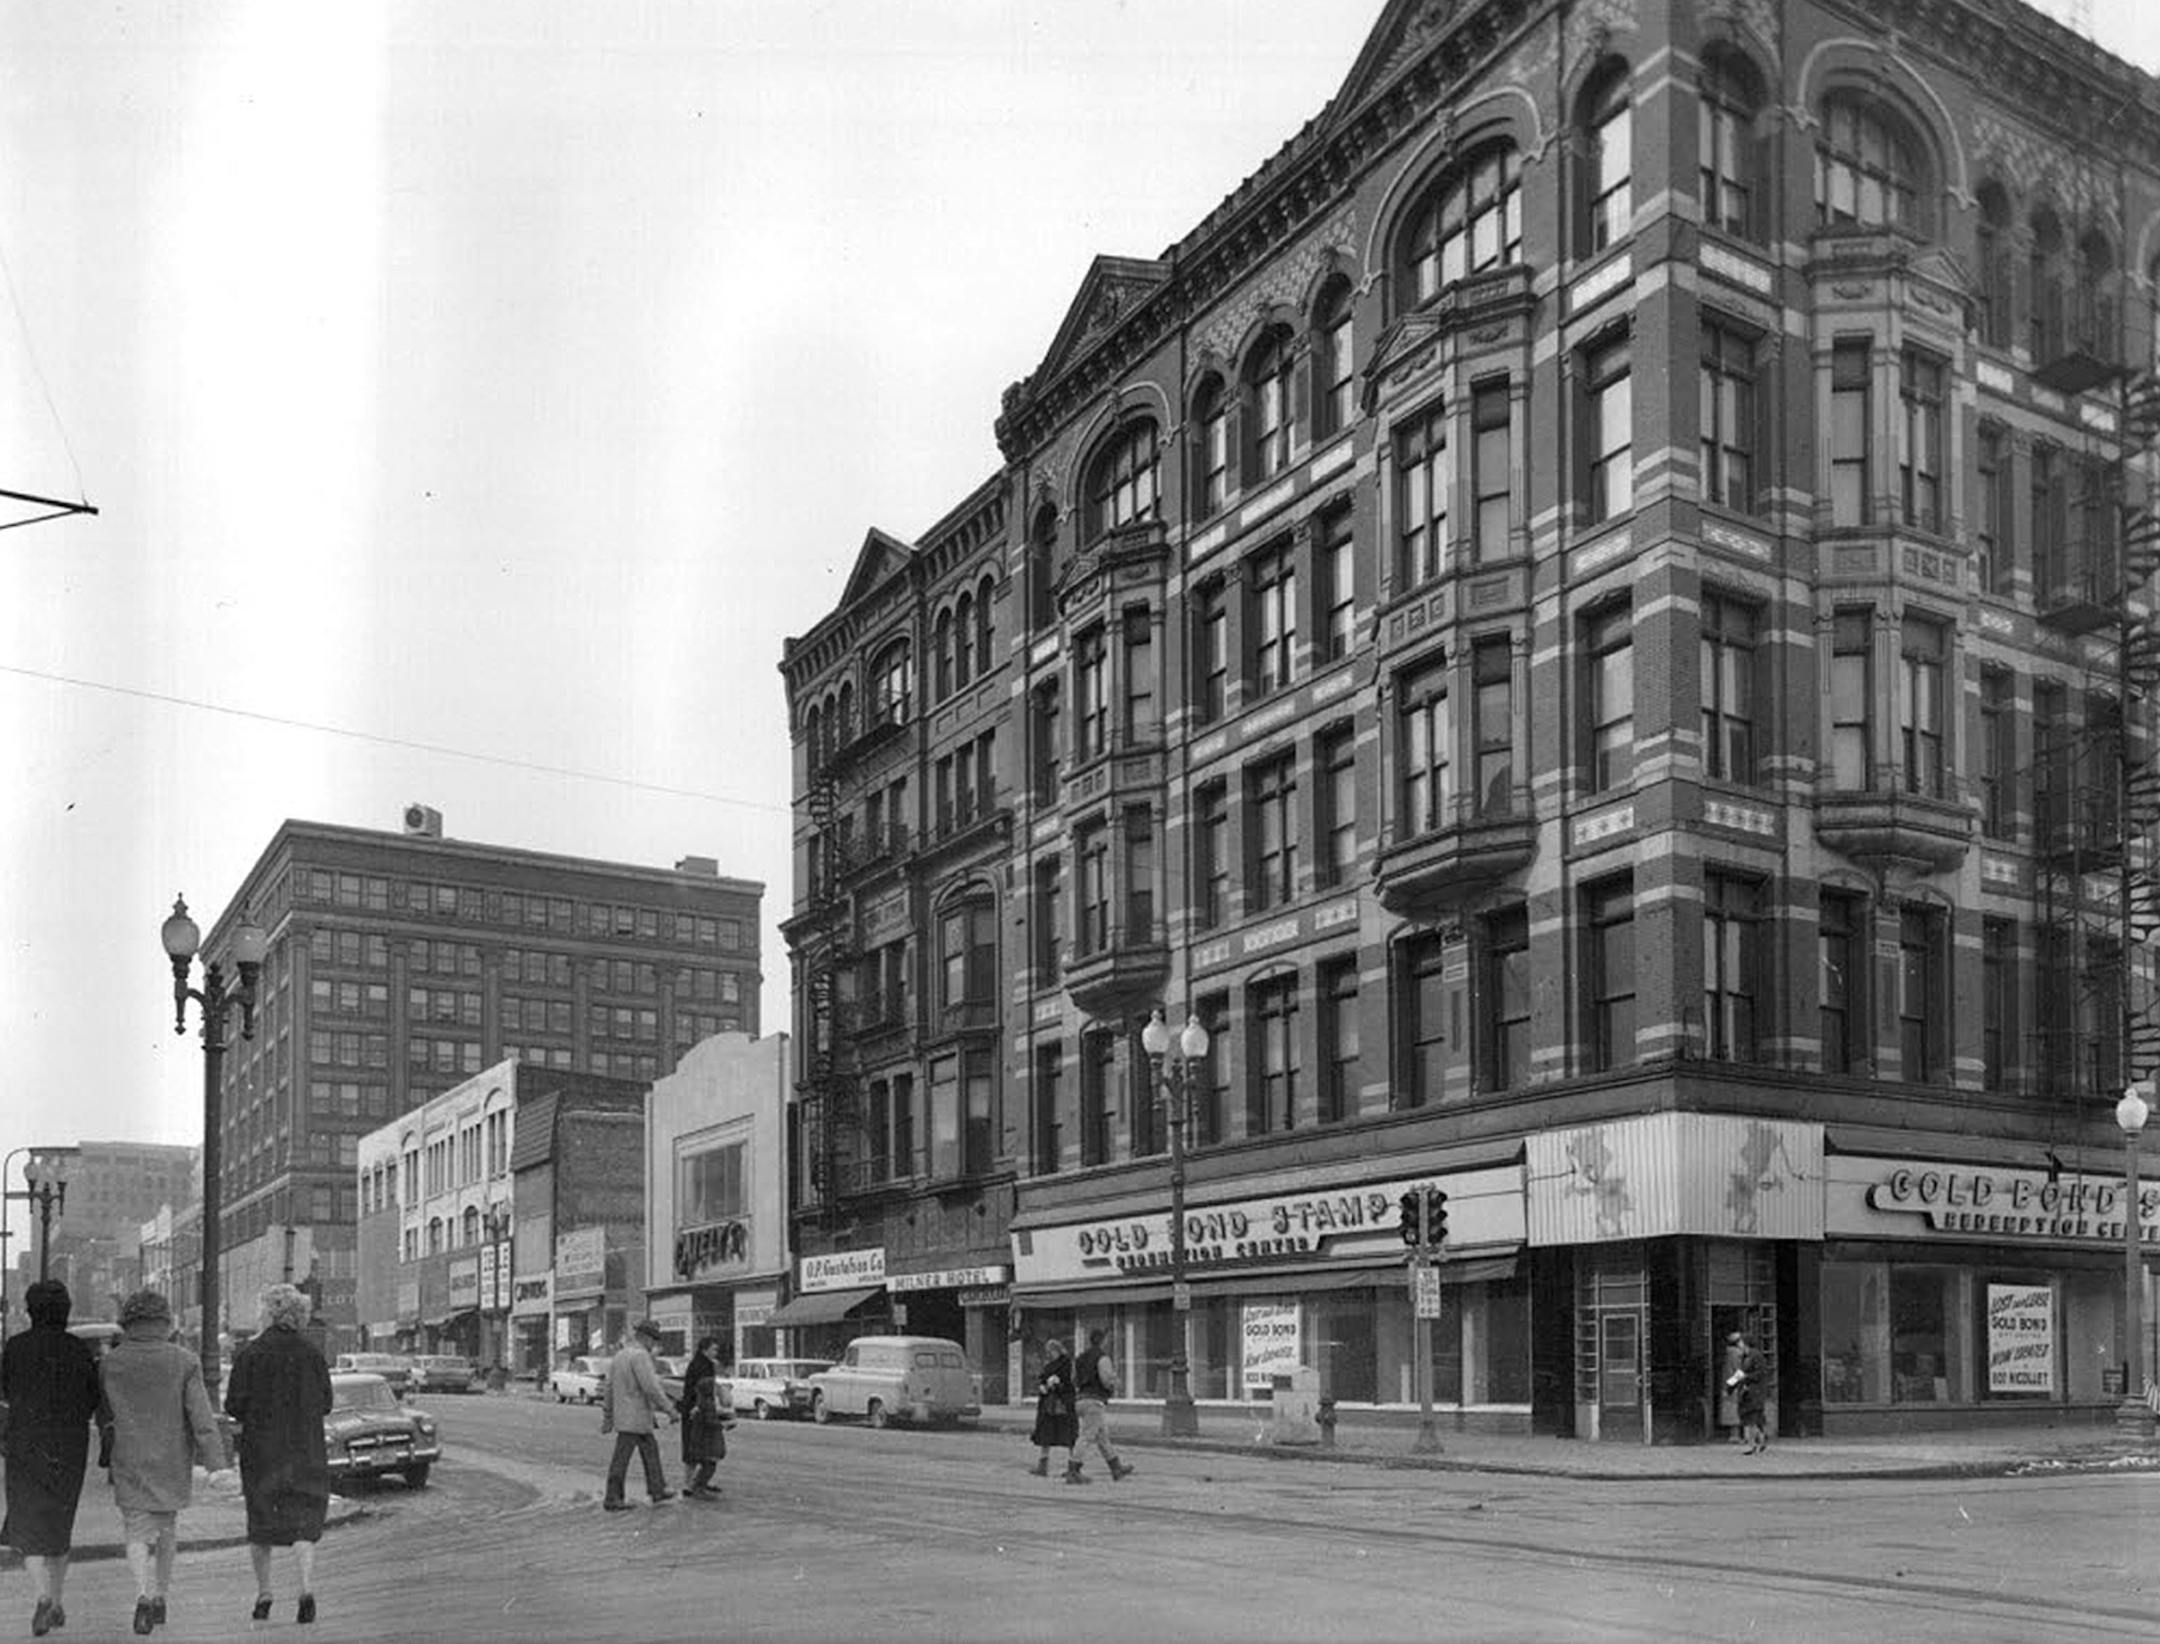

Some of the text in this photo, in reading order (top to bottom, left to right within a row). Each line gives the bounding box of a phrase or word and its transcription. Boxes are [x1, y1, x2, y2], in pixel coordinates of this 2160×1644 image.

[1890, 1168, 1996, 1207] GOLD
[2012, 1178, 2118, 1215] BOND
[1078, 1223, 1149, 1256] GOLD
[1272, 1193, 1389, 1235] STAMP
[1944, 1212, 2089, 1236] REDEMPTION
[893, 1273, 941, 1291] MILNER
[947, 1268, 990, 1286] HOTEL
[1245, 1323, 1296, 1336] GOLD BOND
[1992, 1316, 2047, 1332] GOLD BOND
[2009, 1371, 2049, 1386] NICOLLET
